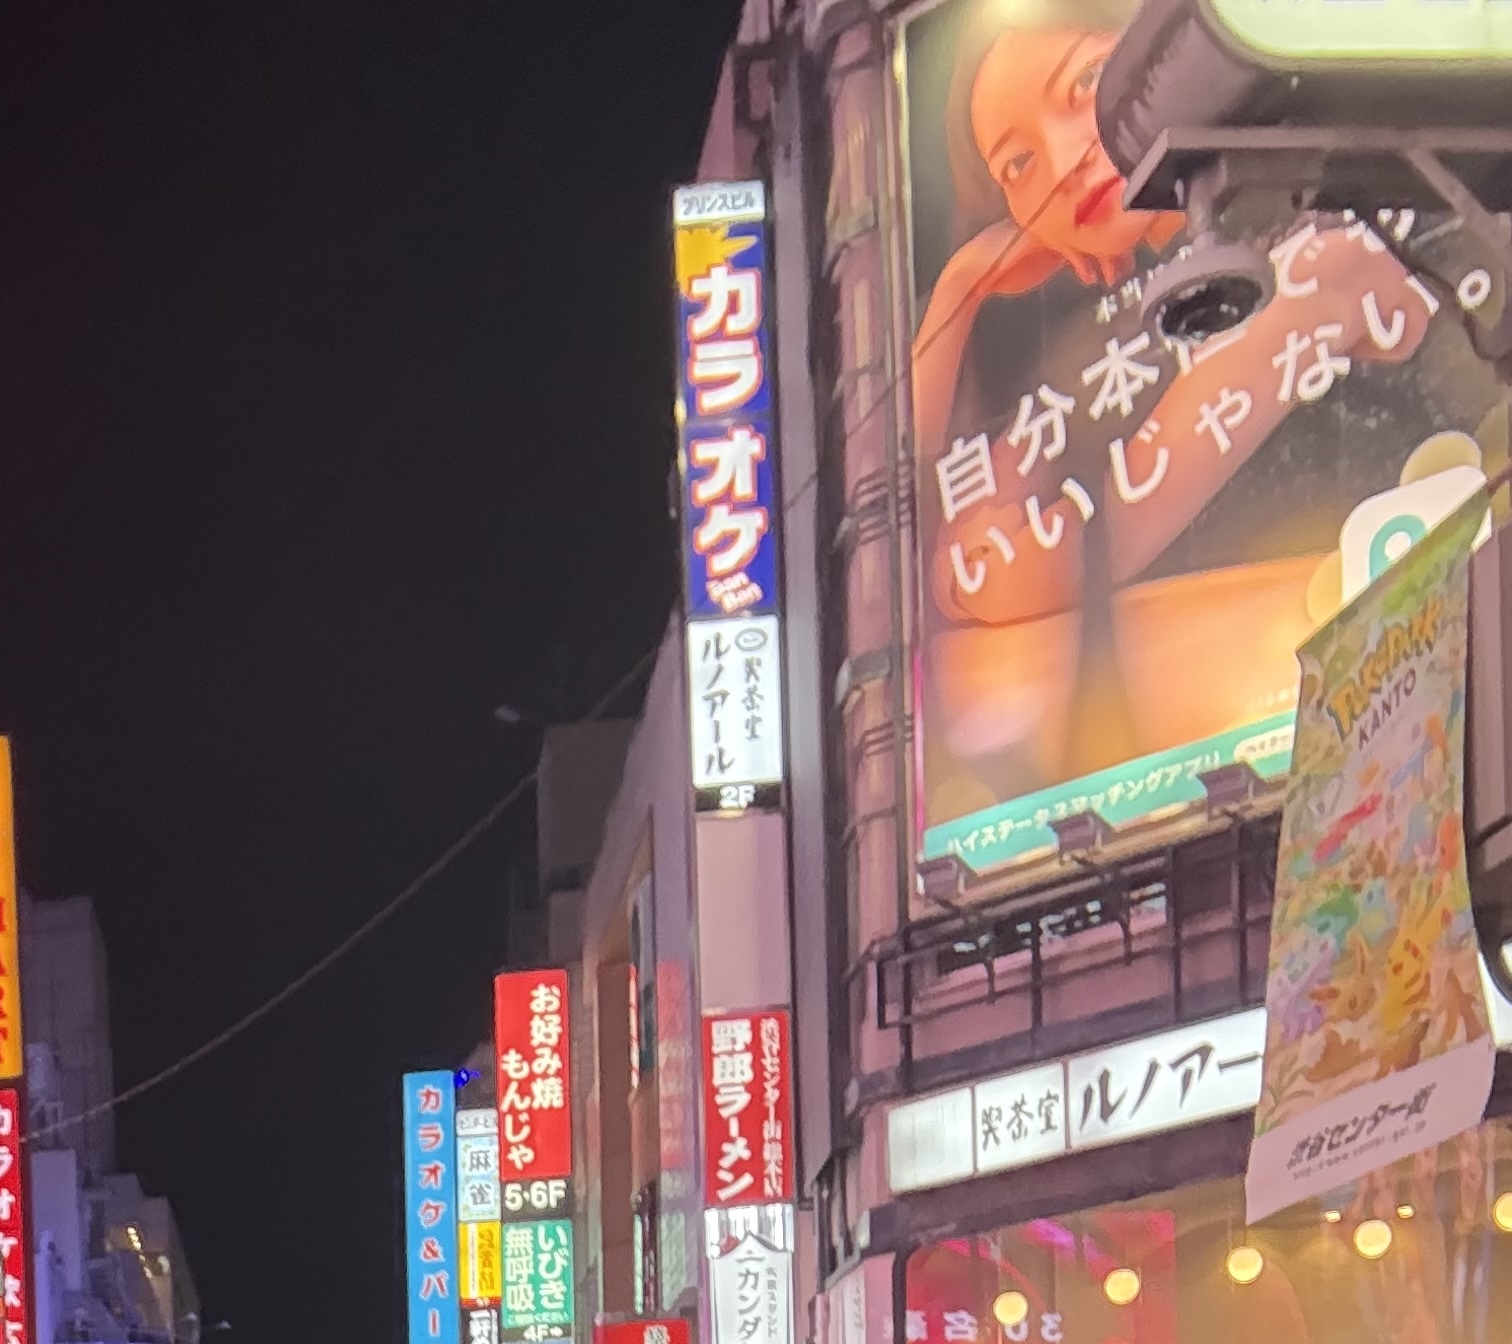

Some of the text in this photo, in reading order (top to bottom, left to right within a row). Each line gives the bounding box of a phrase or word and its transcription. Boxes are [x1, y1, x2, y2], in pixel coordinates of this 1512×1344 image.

[690, 263, 765, 573] カラオケ
[951, 268, 1492, 595] いいじゃない。
[702, 632, 736, 776] ルノアール
[719, 785, 756, 809] 2F
[530, 983, 564, 1109] お好み焼
[500, 1048, 535, 1171] もんじゃ
[711, 1018, 755, 1202] 野郎ラーメン
[980, 1088, 1062, 1148] 喫茶室
[504, 1227, 536, 1313] 無呼吸
[537, 1224, 569, 1311] いびき
